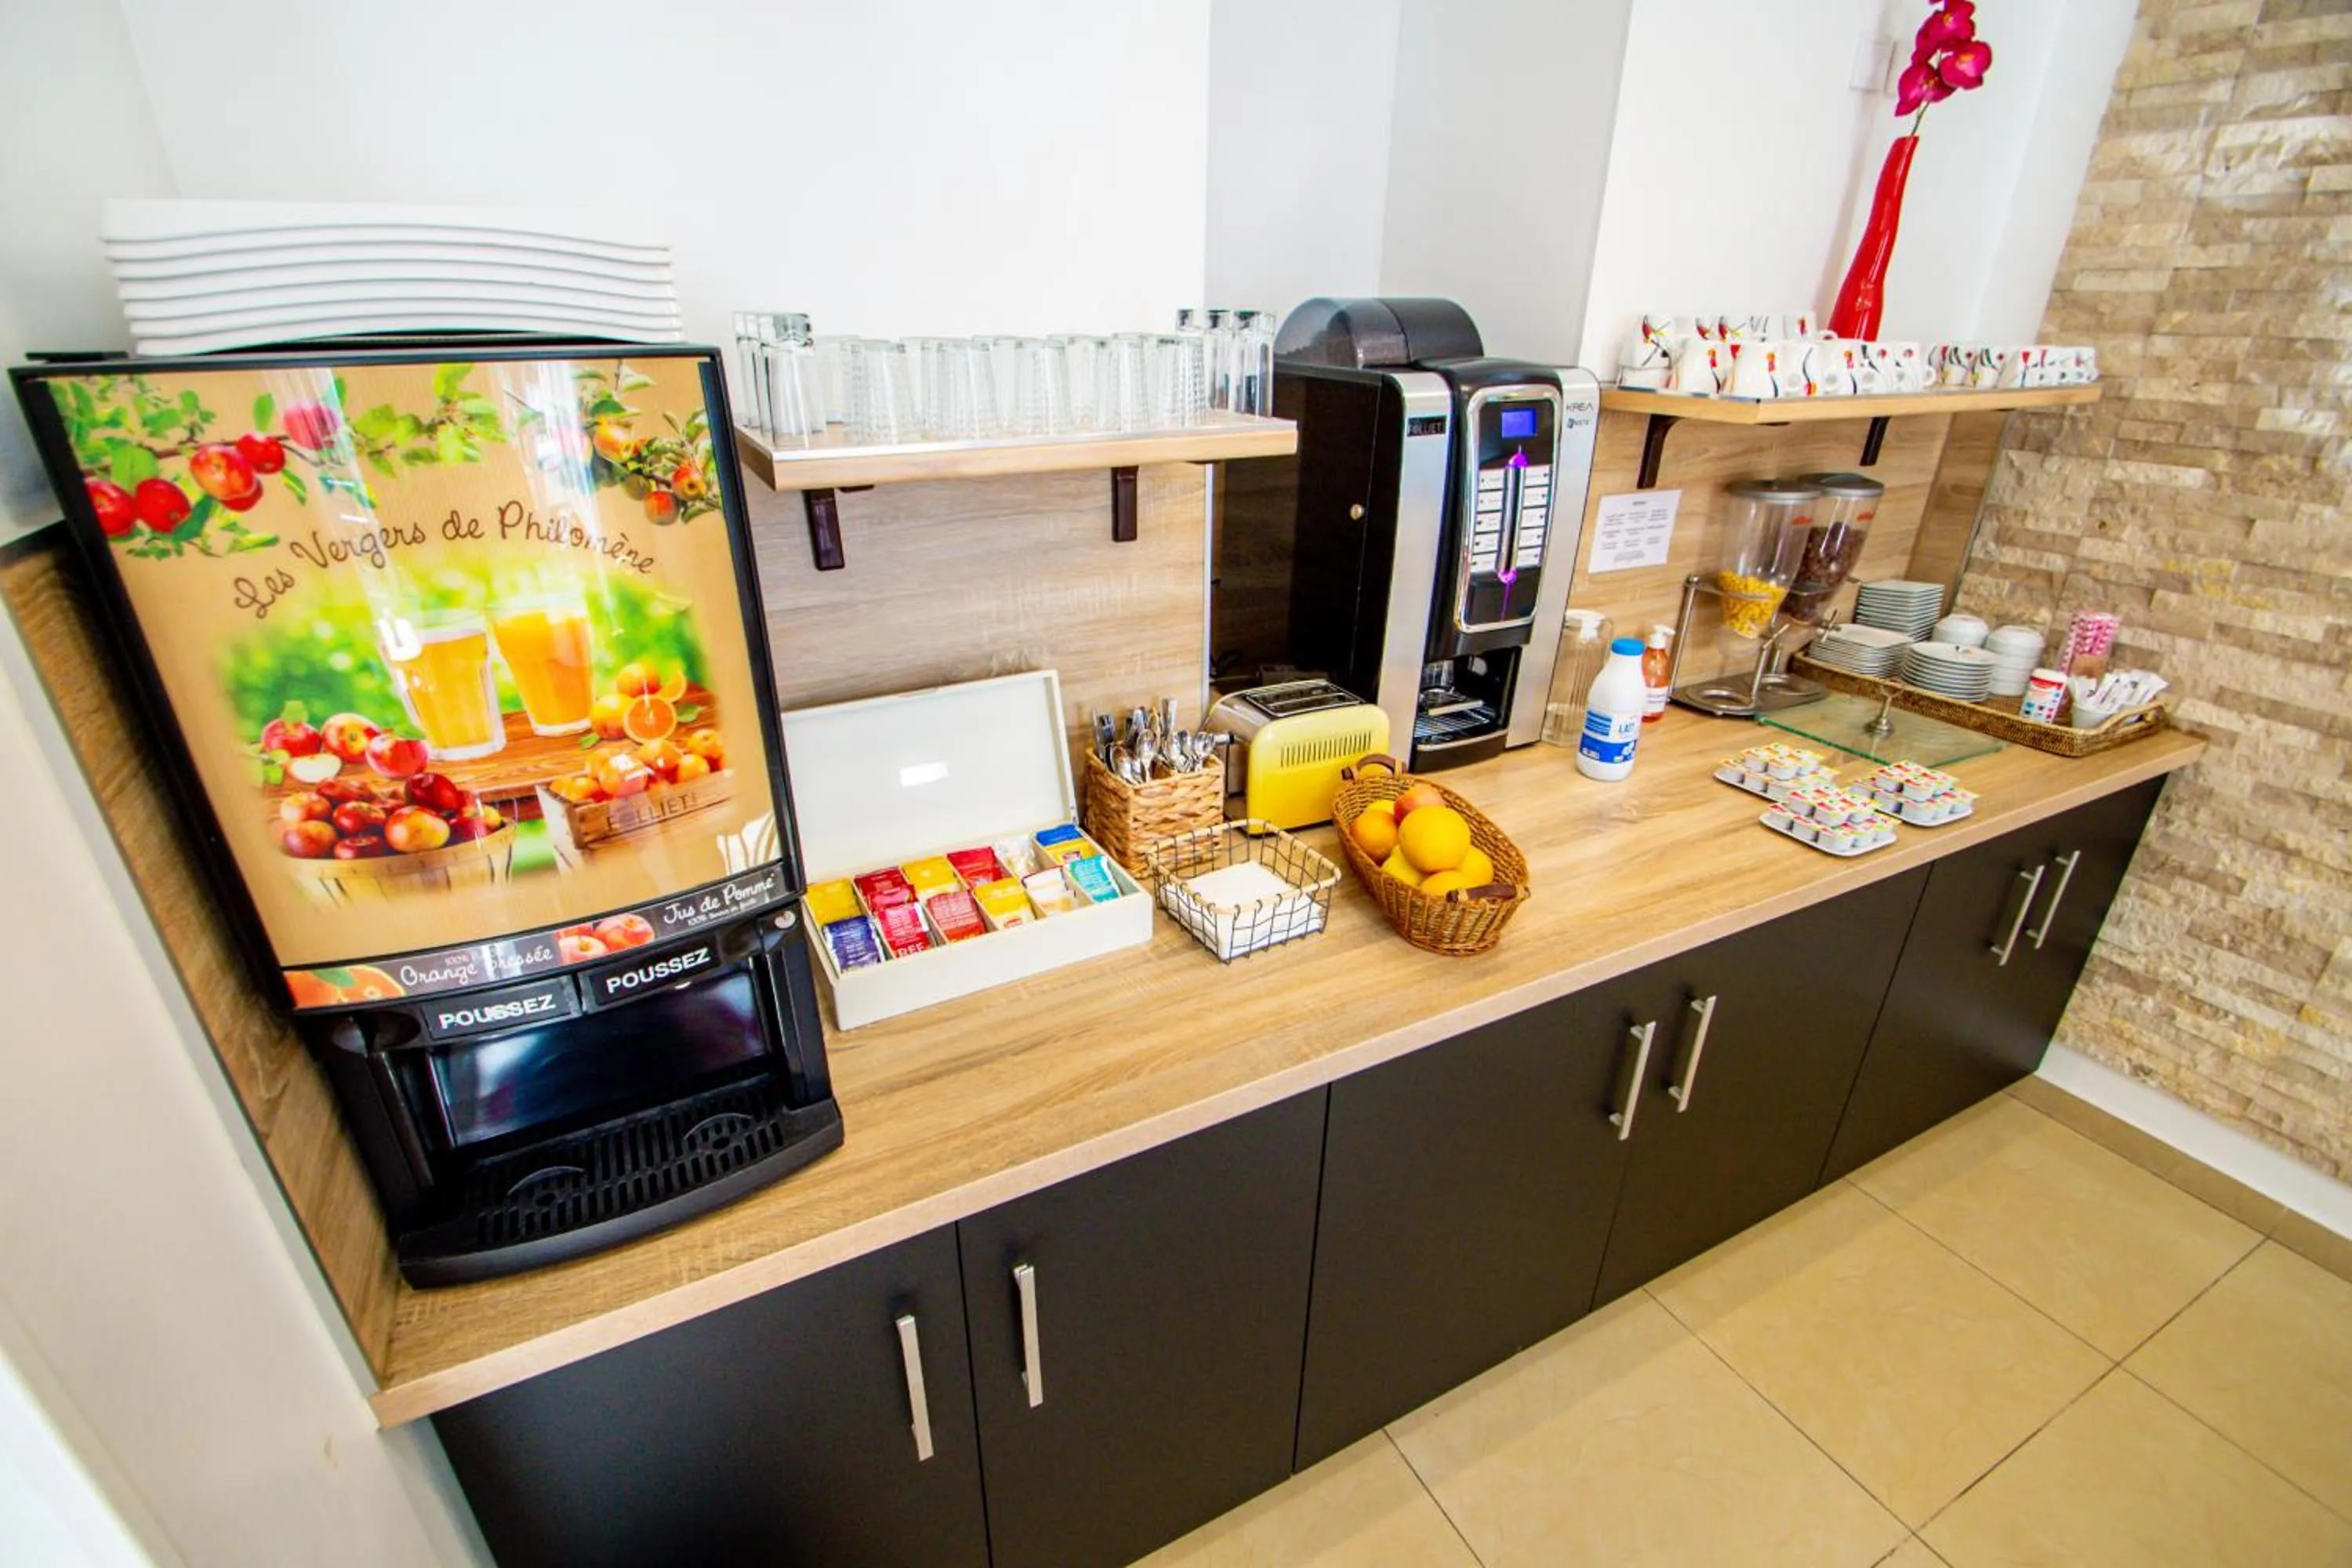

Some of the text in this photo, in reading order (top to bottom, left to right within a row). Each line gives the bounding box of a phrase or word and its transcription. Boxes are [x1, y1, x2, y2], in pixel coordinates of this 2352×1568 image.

[289, 521, 426, 569] Vergers
[442, 510, 485, 540] de
[663, 903, 695, 924] Jus
[700, 896, 720, 912] de
[401, 965, 477, 985] Orange
[606, 947, 712, 994] POUSSEZ
[438, 994, 557, 1029] POUSSEZ
